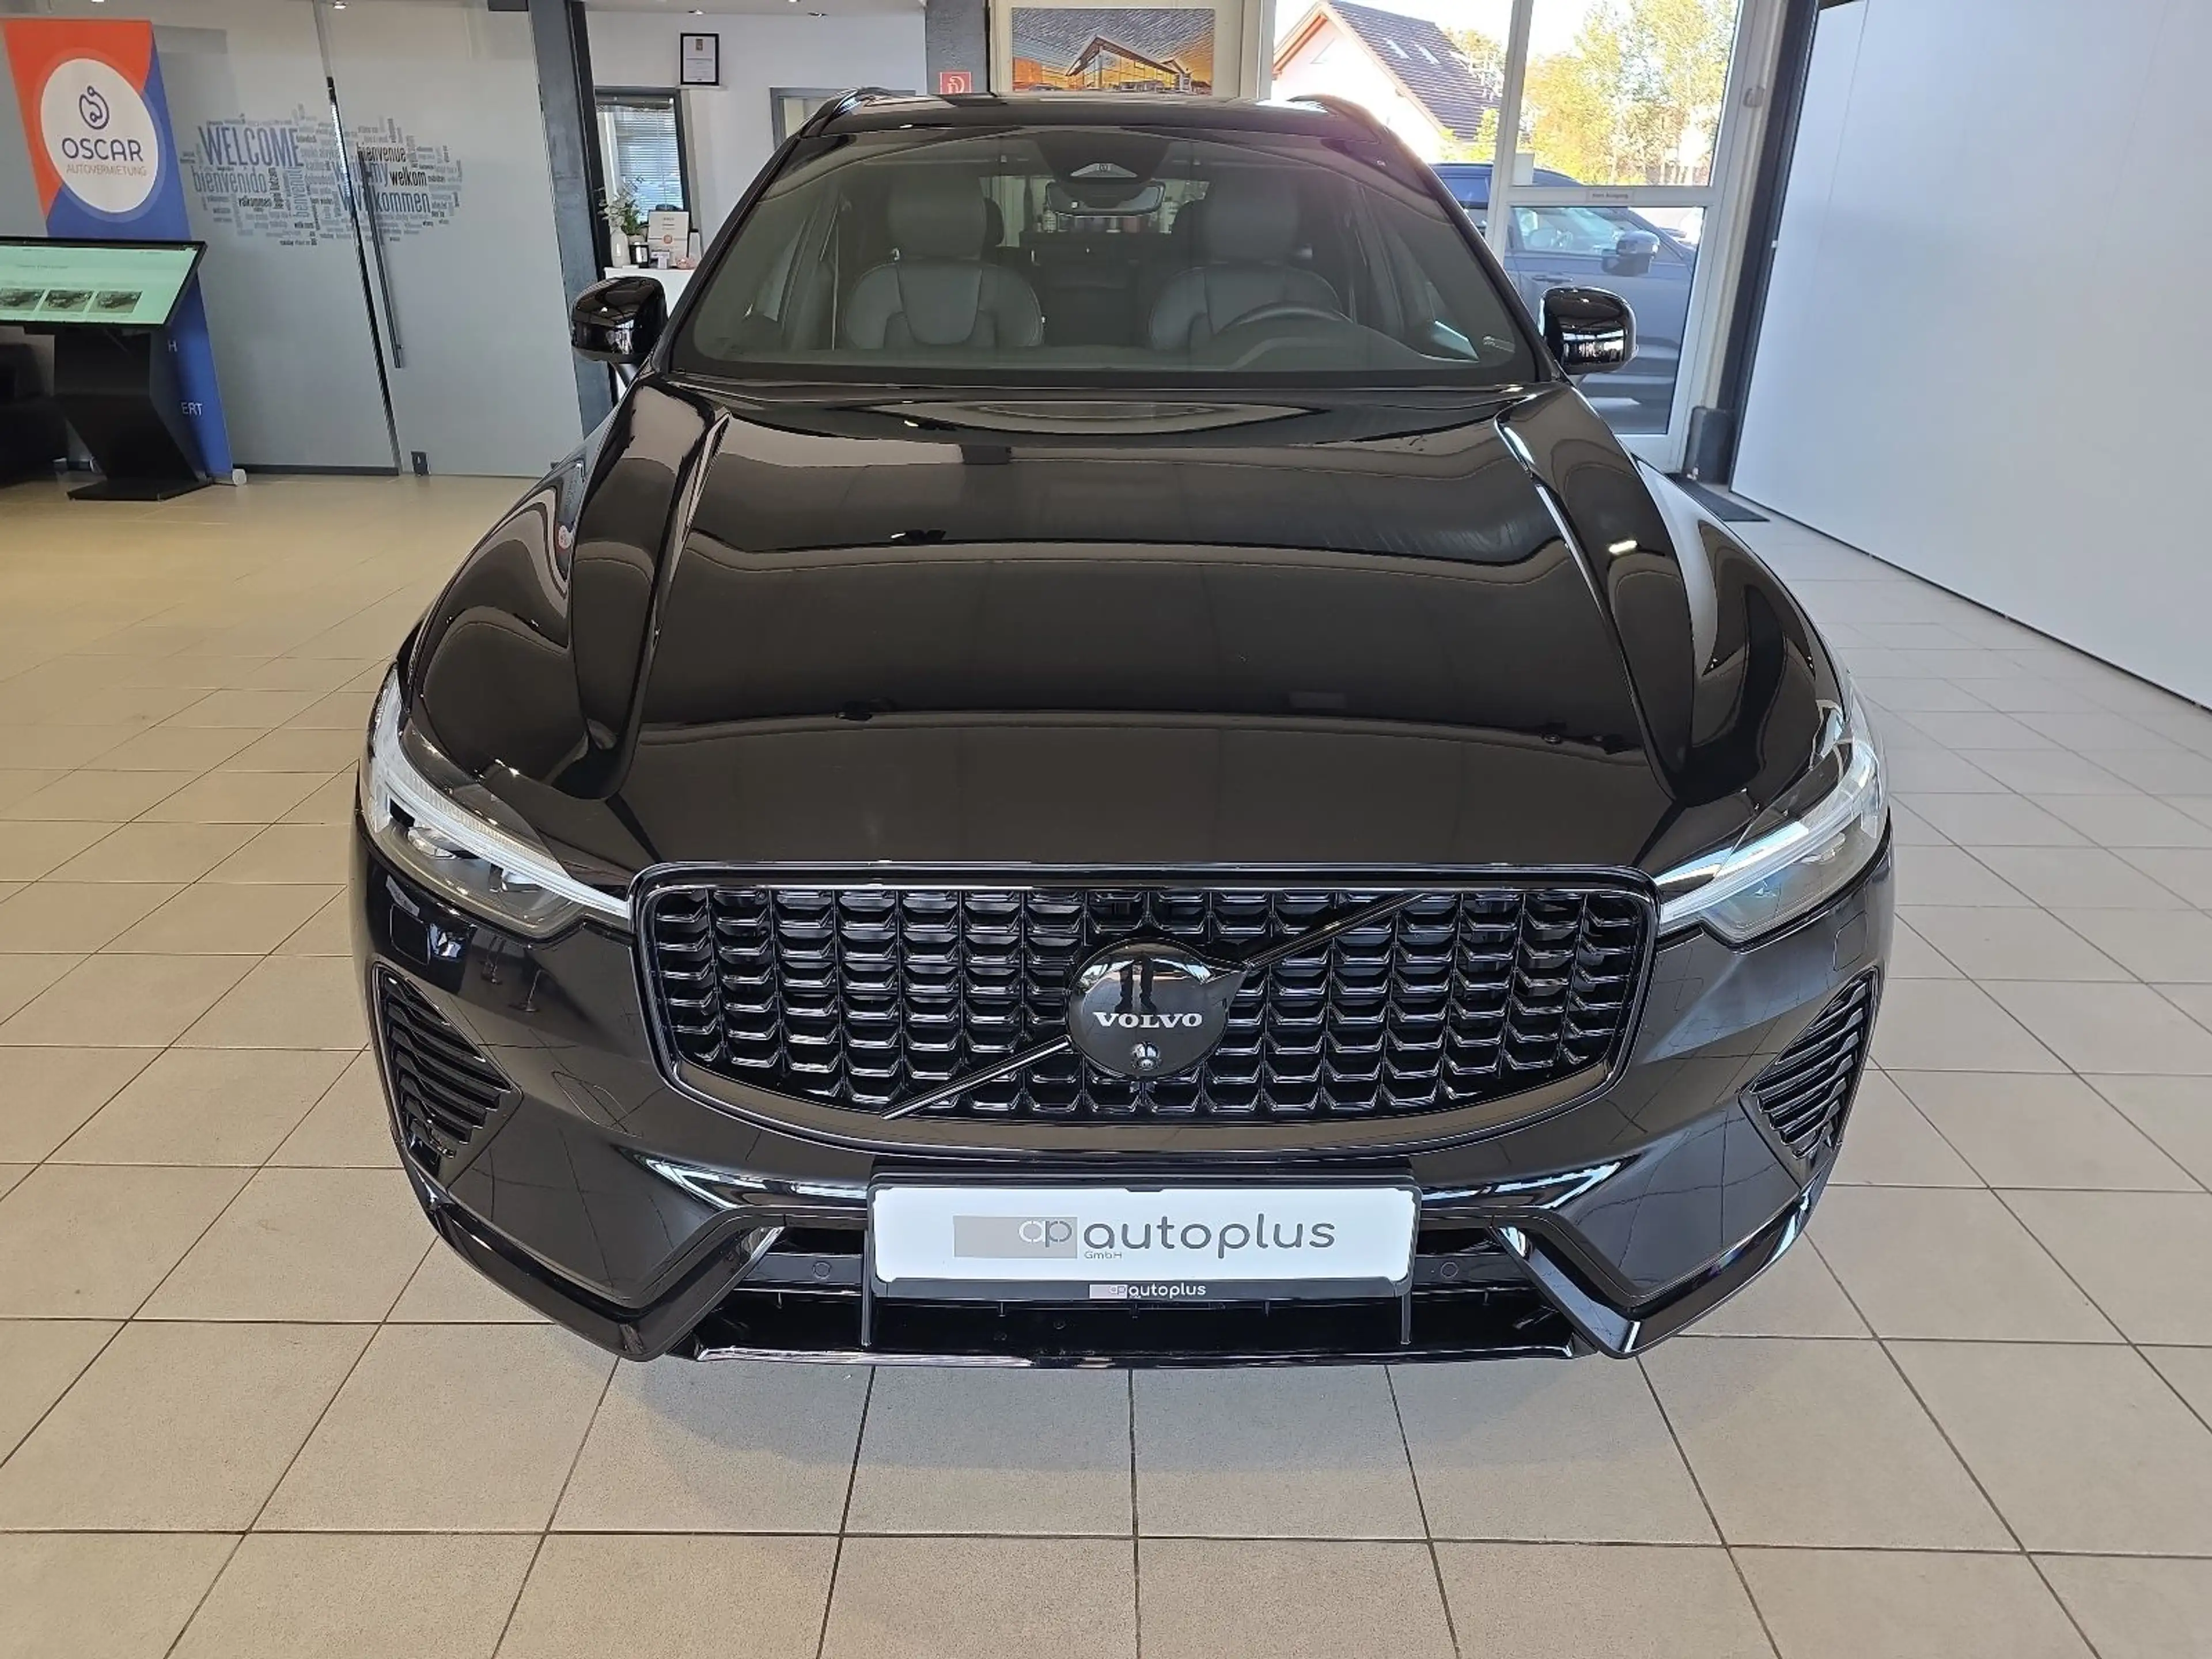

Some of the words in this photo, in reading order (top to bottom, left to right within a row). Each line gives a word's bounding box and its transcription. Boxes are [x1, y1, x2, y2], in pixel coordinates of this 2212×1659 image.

[62, 138, 143, 162] OSCAR
[198, 125, 304, 166] WELCOME
[356, 142, 406, 162] bienvenue
[66, 163, 147, 177] AUTOVERMIETUNG
[191, 165, 268, 194] bienvenido
[389, 166, 427, 186] welkom
[1093, 1012, 1203, 1028] VOLVO
[1084, 1213, 1335, 1259] autoplus
[1084, 1251, 1123, 1259] GmbH
[1128, 1282, 1207, 1299] autoplus
